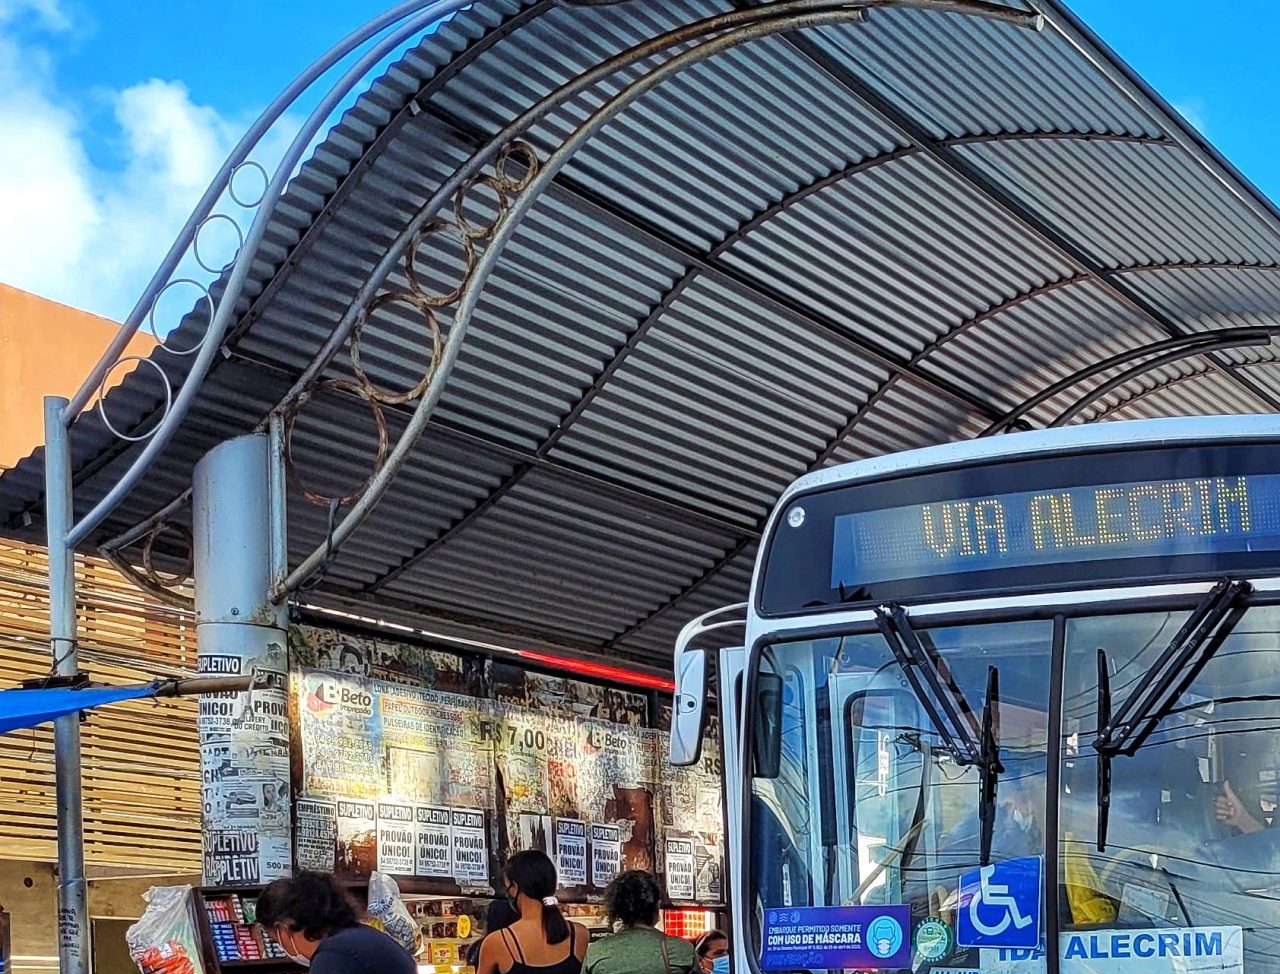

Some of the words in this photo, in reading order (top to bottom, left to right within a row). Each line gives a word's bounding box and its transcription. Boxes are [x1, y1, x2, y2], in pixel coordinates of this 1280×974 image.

[922, 499, 1007, 557] VIA
[1031, 476, 1249, 549] ALECRIM
[341, 688, 371, 707] Beto
[507, 725, 545, 751] 7,00
[605, 733, 627, 749] Beto
[417, 807, 449, 824] SUPLETIVO
[453, 813, 483, 828] SUPLETIVO
[558, 822, 584, 836] SUPLETIVO
[380, 830, 412, 844] PROVÃO
[418, 833, 449, 847] PROVÃO
[454, 836, 484, 849] PROVÃO
[382, 843, 410, 858] ÚNICO!
[421, 846, 447, 861] ÚNICO!
[456, 851, 482, 863] ÚNICO!
[559, 844, 585, 857] PROVÃO
[561, 855, 583, 870] ÚNICO!
[768, 927, 798, 935] EMBARQUE
[830, 924, 862, 933] SOMENTE
[767, 934, 784, 946] COM
[785, 934, 801, 945] USO
[802, 933, 814, 944] DE
[815, 931, 862, 944] MÁSCARA
[1064, 932, 1222, 960] ALECRIM
